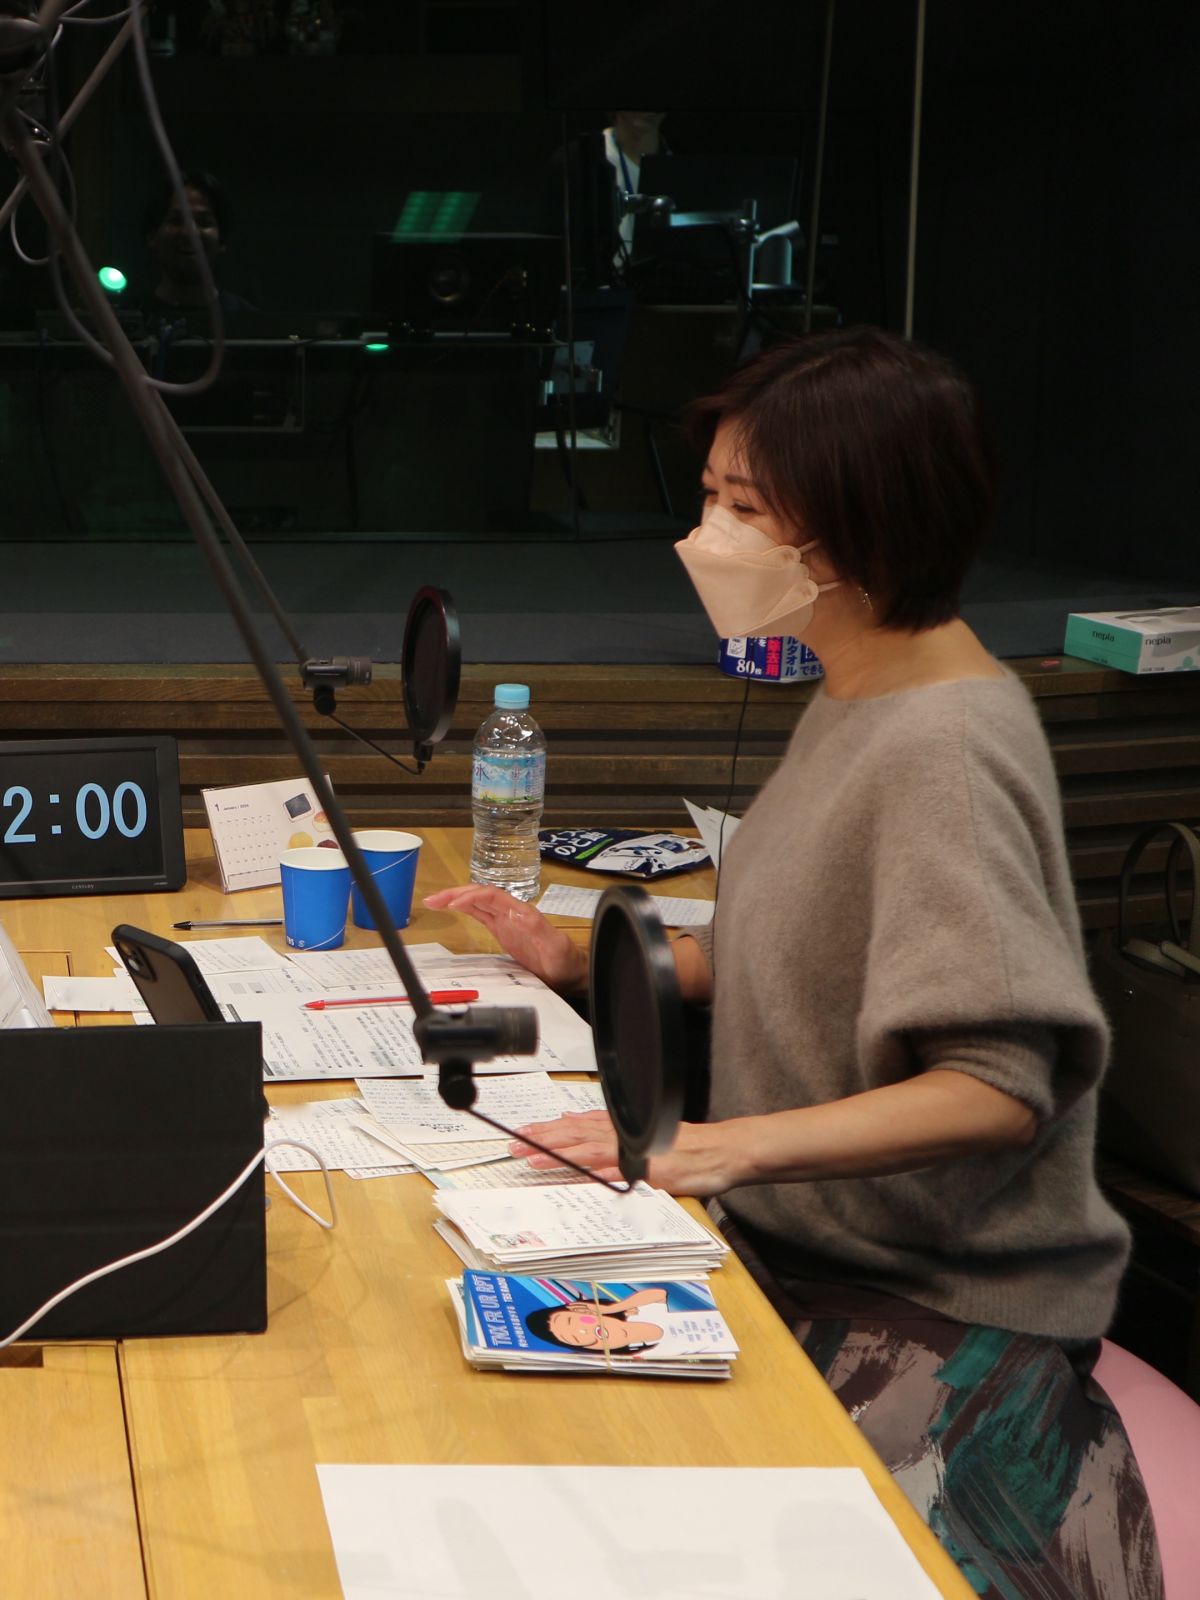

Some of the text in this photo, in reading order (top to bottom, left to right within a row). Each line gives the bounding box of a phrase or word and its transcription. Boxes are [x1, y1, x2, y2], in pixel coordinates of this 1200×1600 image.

[2, 780, 148, 844] 2:00
[471, 1274, 512, 1345] TNX FR UR RPT
